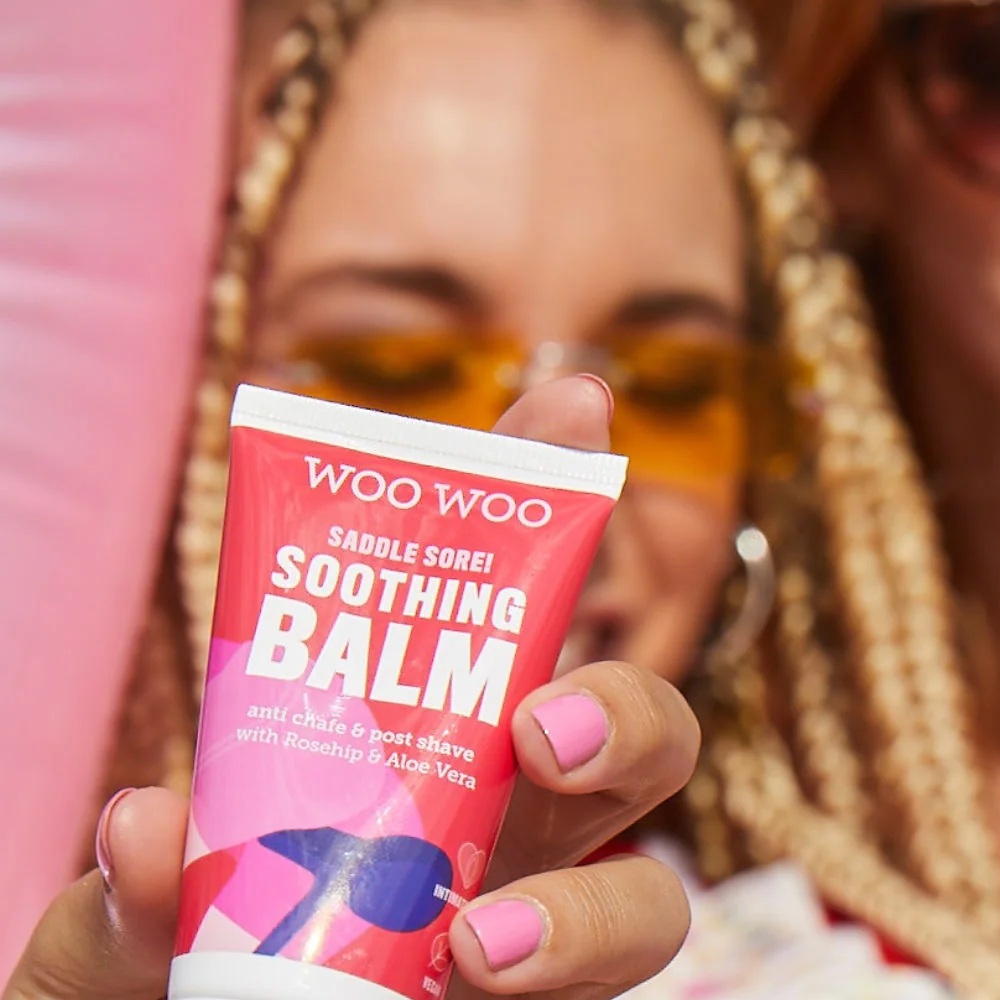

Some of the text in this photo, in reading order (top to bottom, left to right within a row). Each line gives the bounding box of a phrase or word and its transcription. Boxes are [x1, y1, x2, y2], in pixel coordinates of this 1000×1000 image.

[304, 456, 553, 529] WOO WOO
[328, 526, 495, 574] SADDLE SORE!
[271, 545, 528, 636] SOOTHING
[245, 594, 519, 727] BALM
[236, 727, 477, 790] with Rosehip & Aloe Vera
[246, 704, 476, 763] anti chafe & post shave
